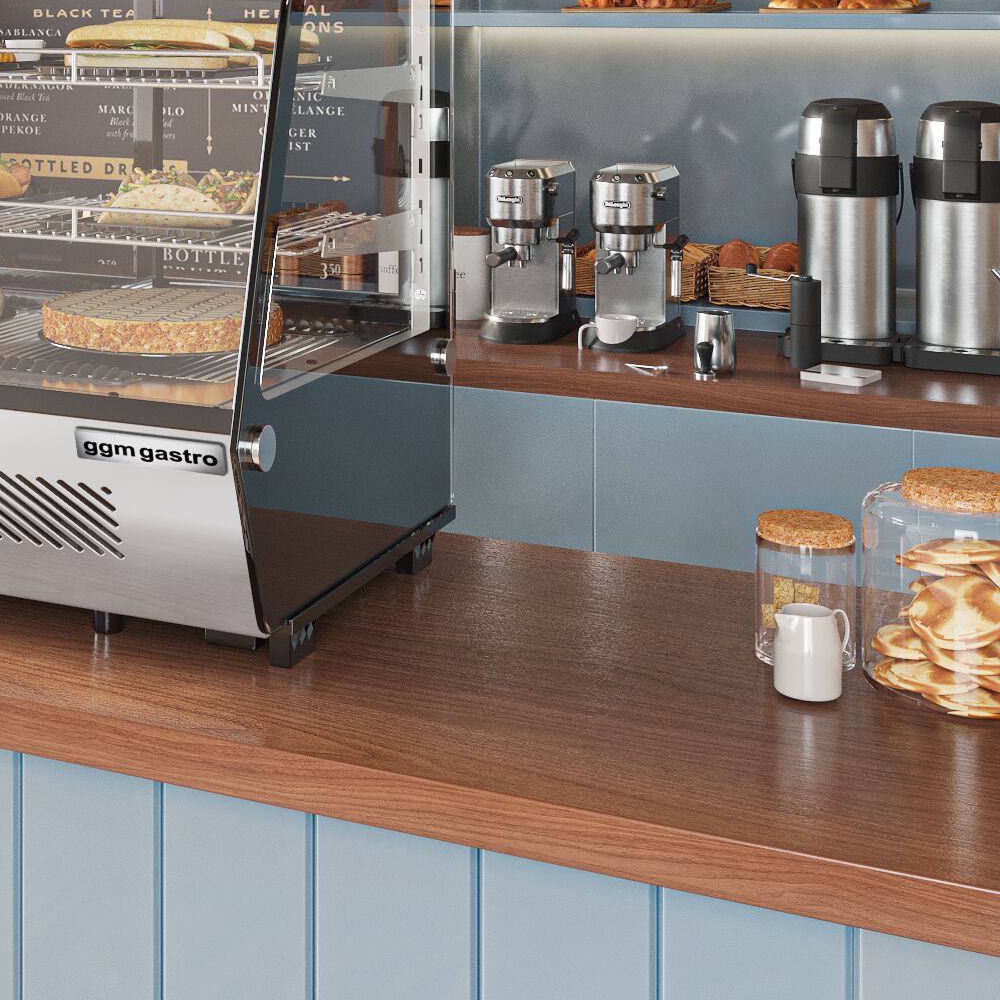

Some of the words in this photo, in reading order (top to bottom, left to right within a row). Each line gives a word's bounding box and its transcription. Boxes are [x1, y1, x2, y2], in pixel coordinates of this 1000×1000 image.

[33, 8, 92, 18] BLACK
[101, 9, 134, 18] TEA
[99, 105, 134, 115] MARC
[232, 103, 268, 113] MINT
[1, 125, 41, 135] PEKOE
[162, 248, 245, 266] BOTTLE
[84, 440, 135, 457] ggm
[139, 447, 217, 466] gastro
